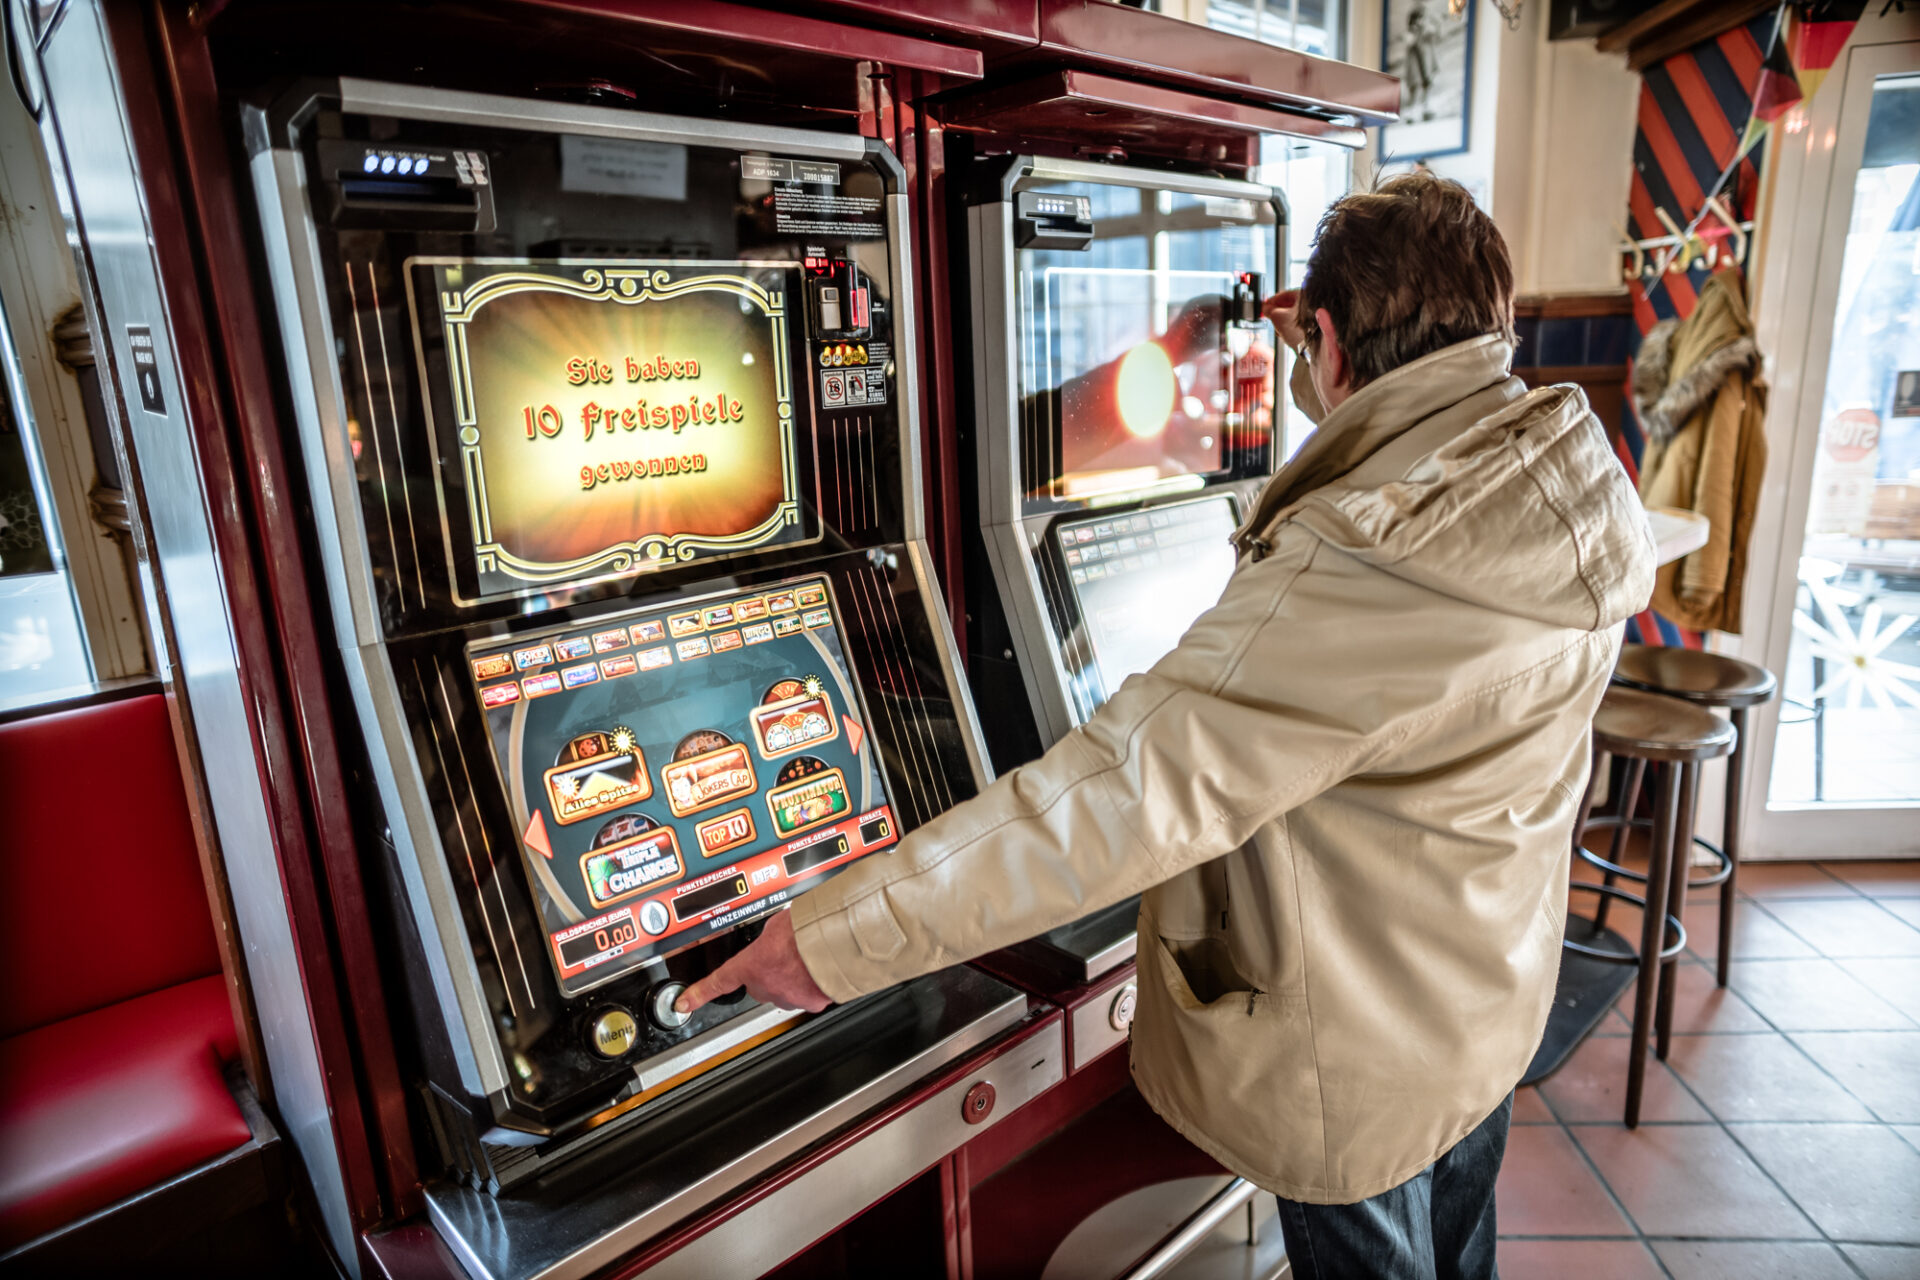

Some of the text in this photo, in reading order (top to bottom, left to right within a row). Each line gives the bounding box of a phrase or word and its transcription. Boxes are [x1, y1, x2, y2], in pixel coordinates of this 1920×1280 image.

[565, 355, 701, 385] Sie haben
[522, 391, 744, 441] 10 Freispiele
[579, 452, 707, 490] gewonnen
[744, 625, 770, 640] BINGO
[516, 647, 549, 662] POKER
[564, 784, 640, 814] Alles Spitze
[859, 809, 882, 824] EINSATZ
[879, 822, 889, 837] 0
[706, 817, 749, 846] TOP 10
[788, 827, 837, 851] PUNKTE-GEWINN
[838, 838, 848, 854] 0
[608, 854, 679, 893] CHANCE
[676, 866, 737, 895] PUNKTESPEICHER
[735, 878, 746, 895] 0
[710, 891, 788, 930] MÜNZEINWURF FREI
[555, 917, 609, 943] GELDSPEICHER
[594, 923, 635, 951] 0.00
